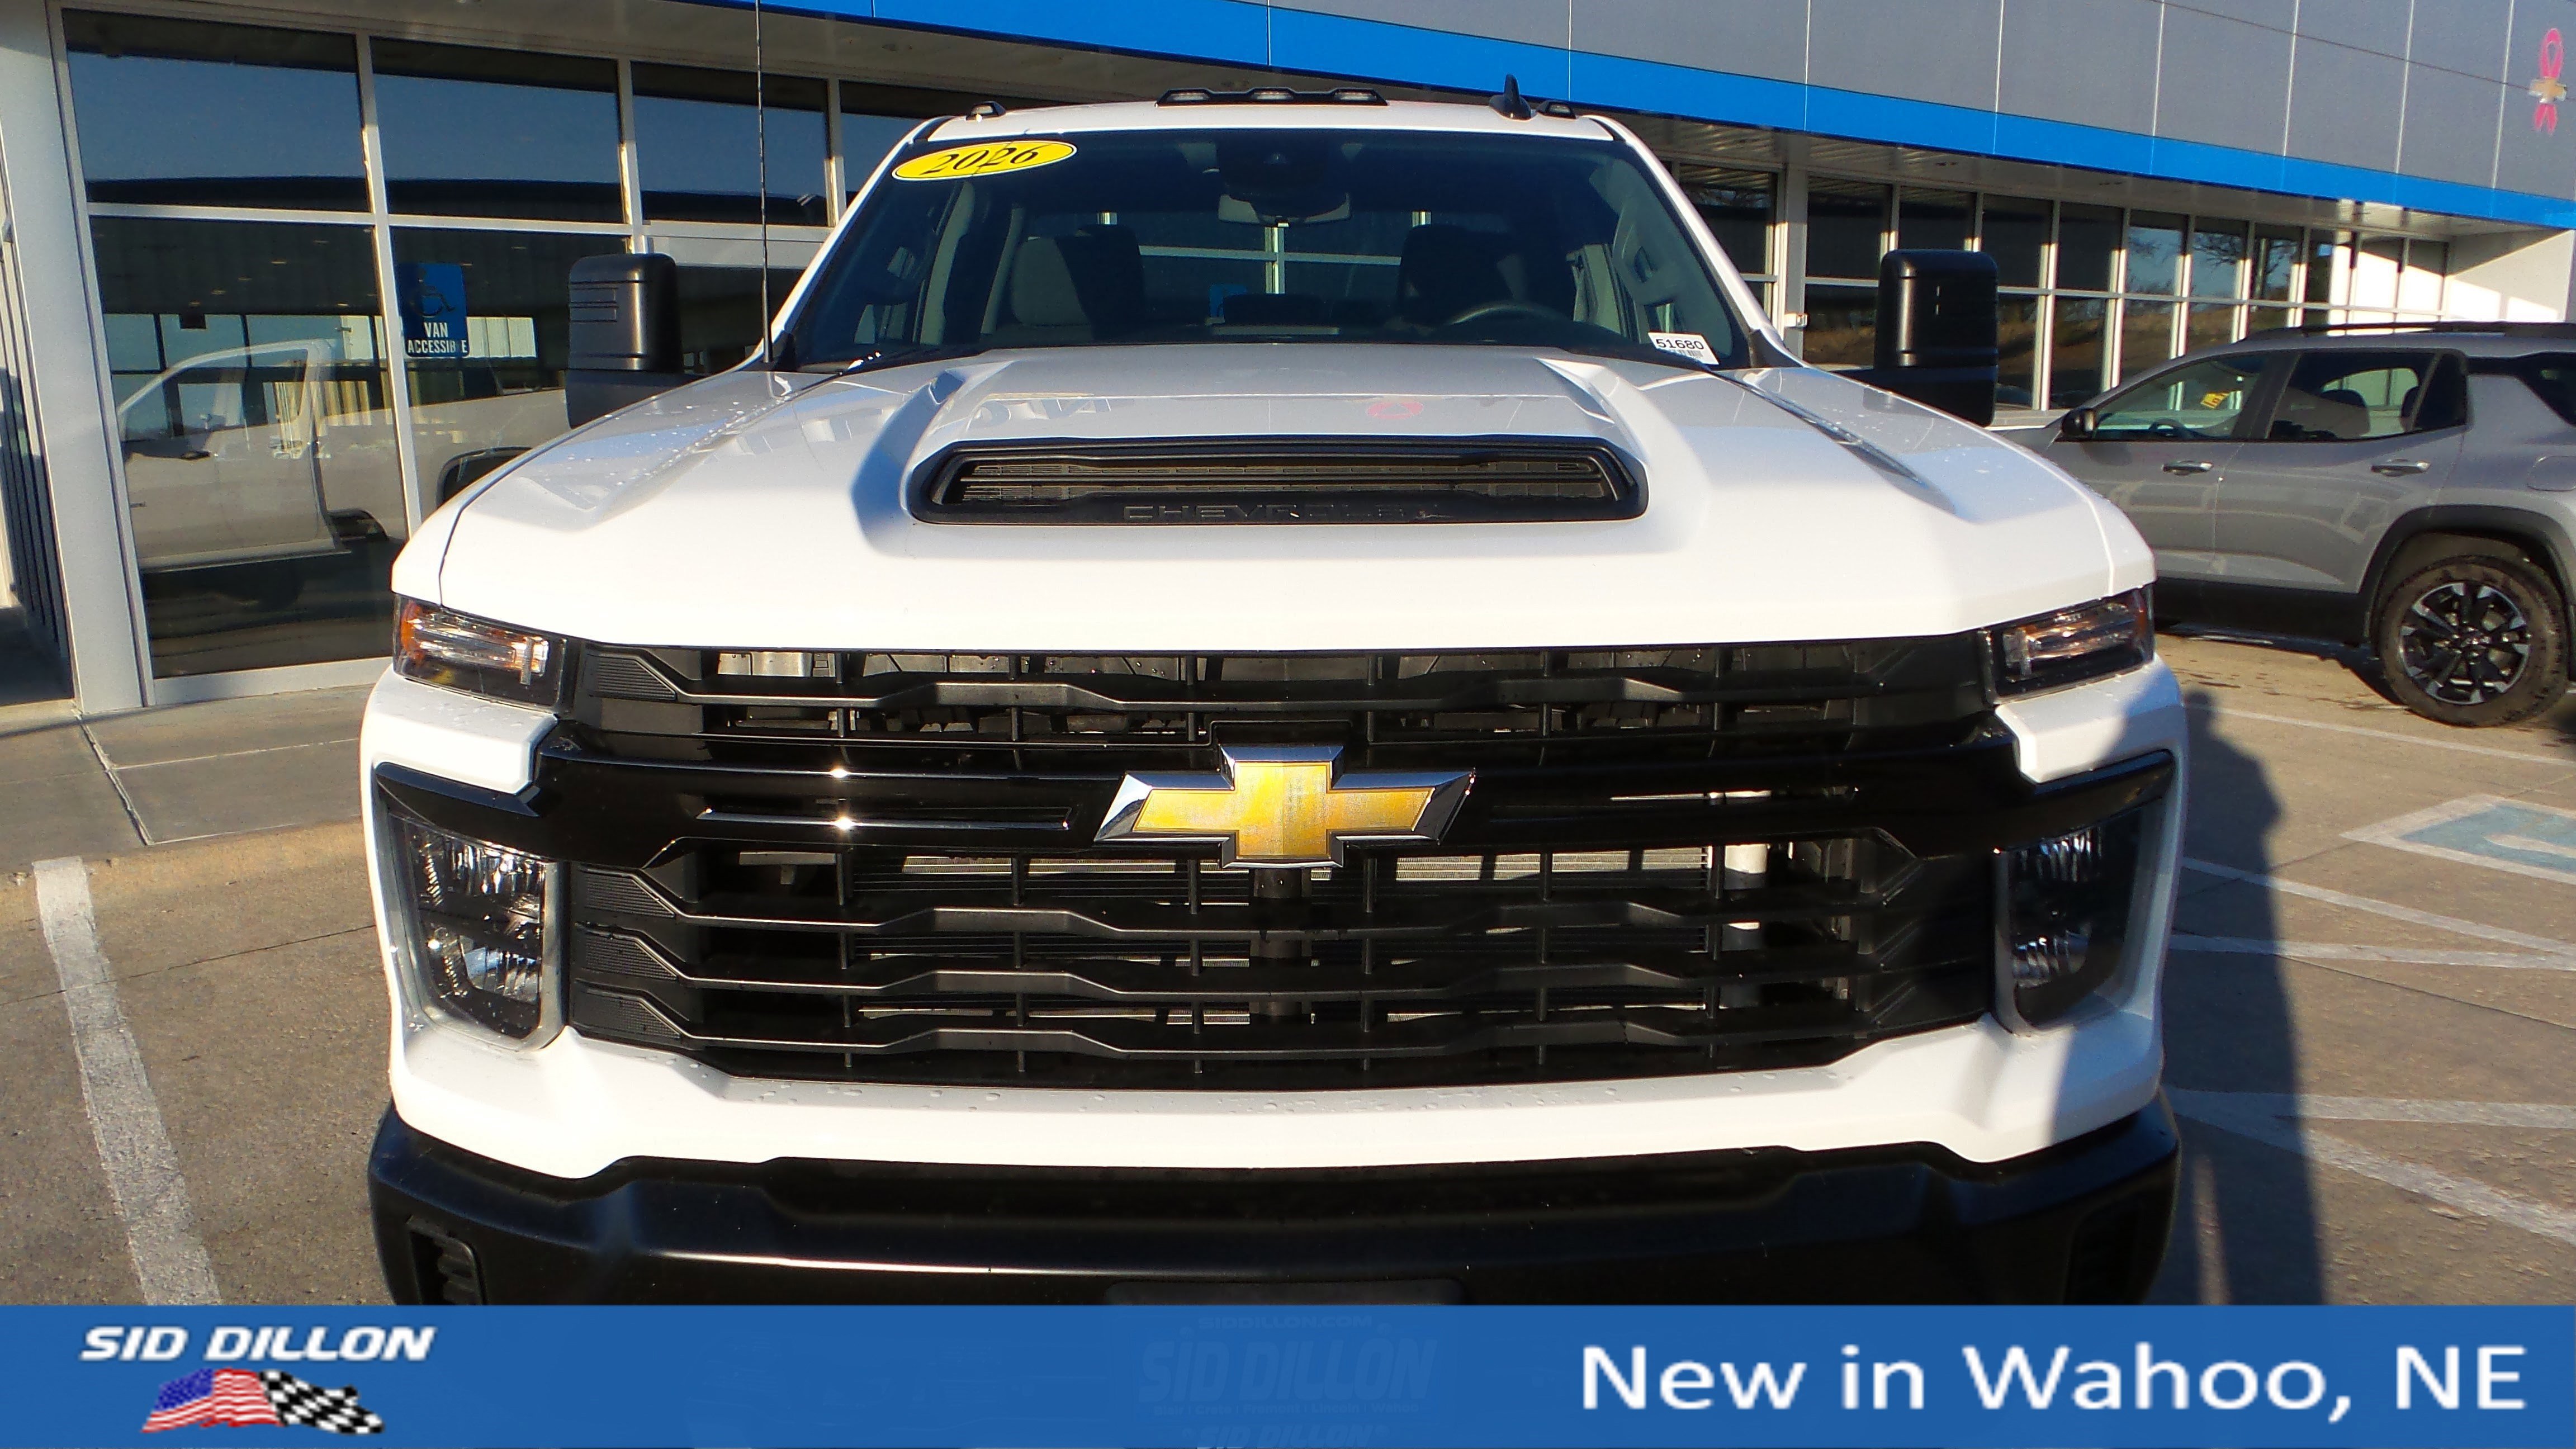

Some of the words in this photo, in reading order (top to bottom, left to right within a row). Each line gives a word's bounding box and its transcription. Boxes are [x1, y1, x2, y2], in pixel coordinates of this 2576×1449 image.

[919, 144, 1052, 176] 2026
[424, 322, 448, 338] VAN
[408, 339, 468, 353] ACCESSIBE
[1656, 338, 1704, 350] 51680
[1123, 504, 1438, 521] CHEVROLE
[1138, 1339, 1231, 1403] SID
[1239, 1337, 1438, 1401] DILLON
